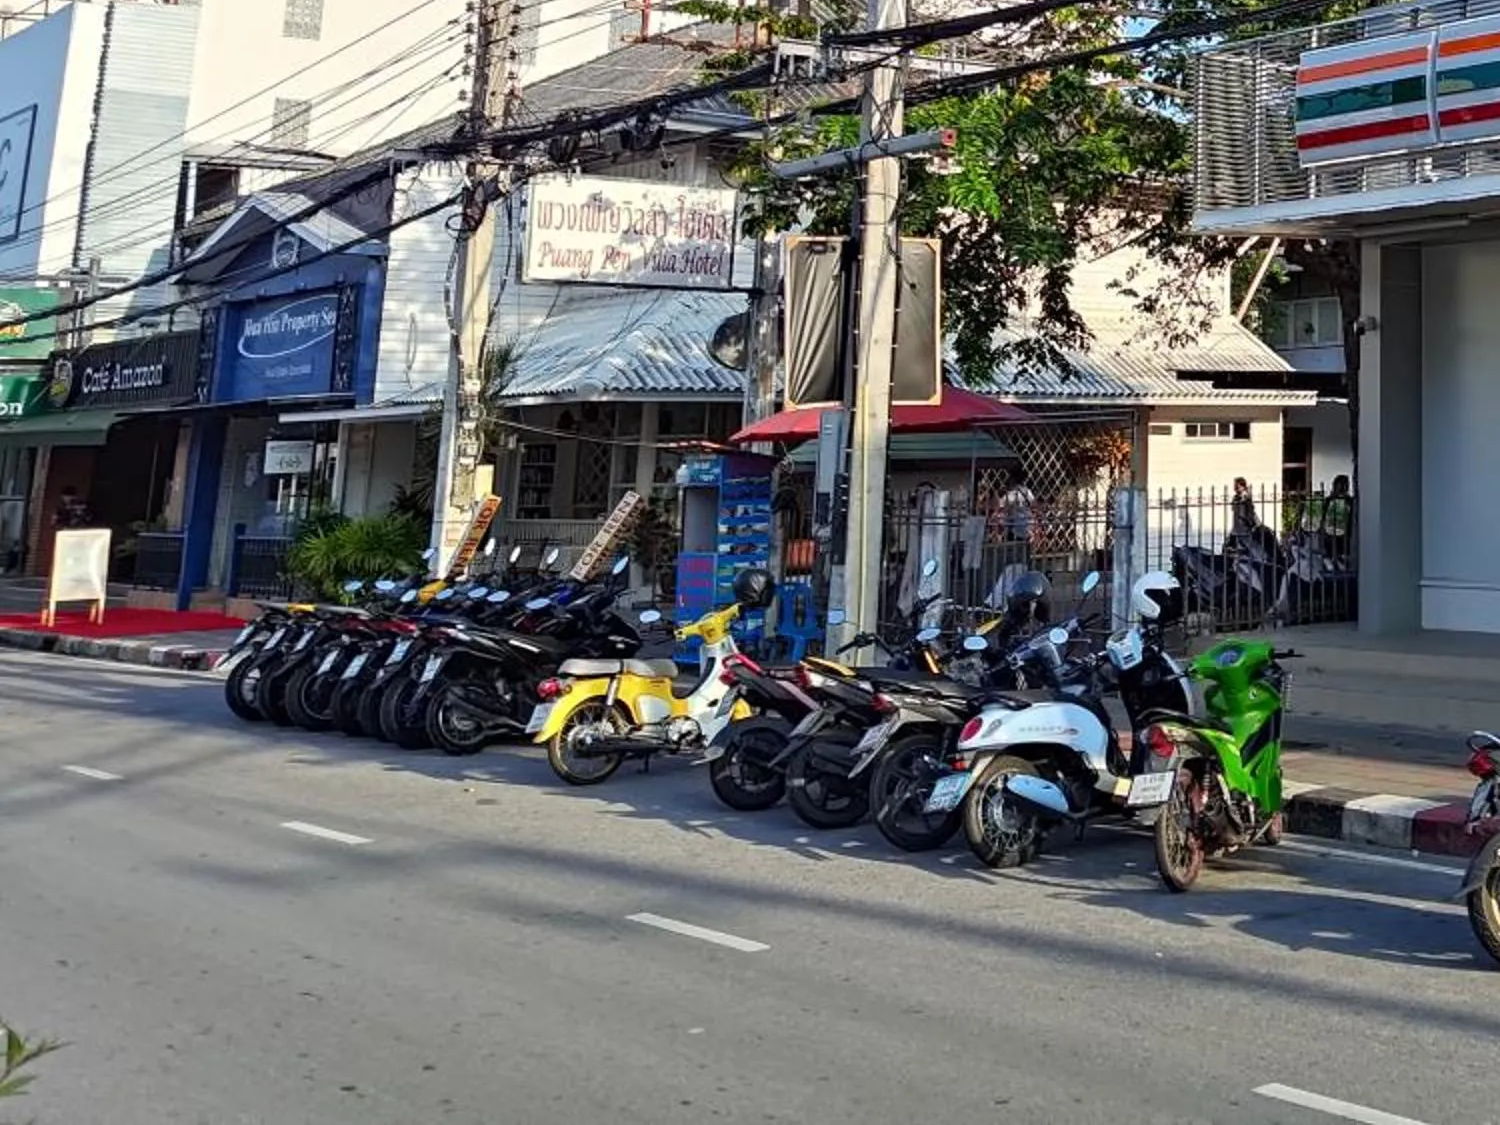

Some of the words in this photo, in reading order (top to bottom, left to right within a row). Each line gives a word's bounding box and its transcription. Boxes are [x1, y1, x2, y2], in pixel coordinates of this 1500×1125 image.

[537, 241, 594, 279] Puang
[600, 245, 632, 273] Pen
[679, 245, 727, 276] Hotel
[111, 361, 164, 391] Amazon
